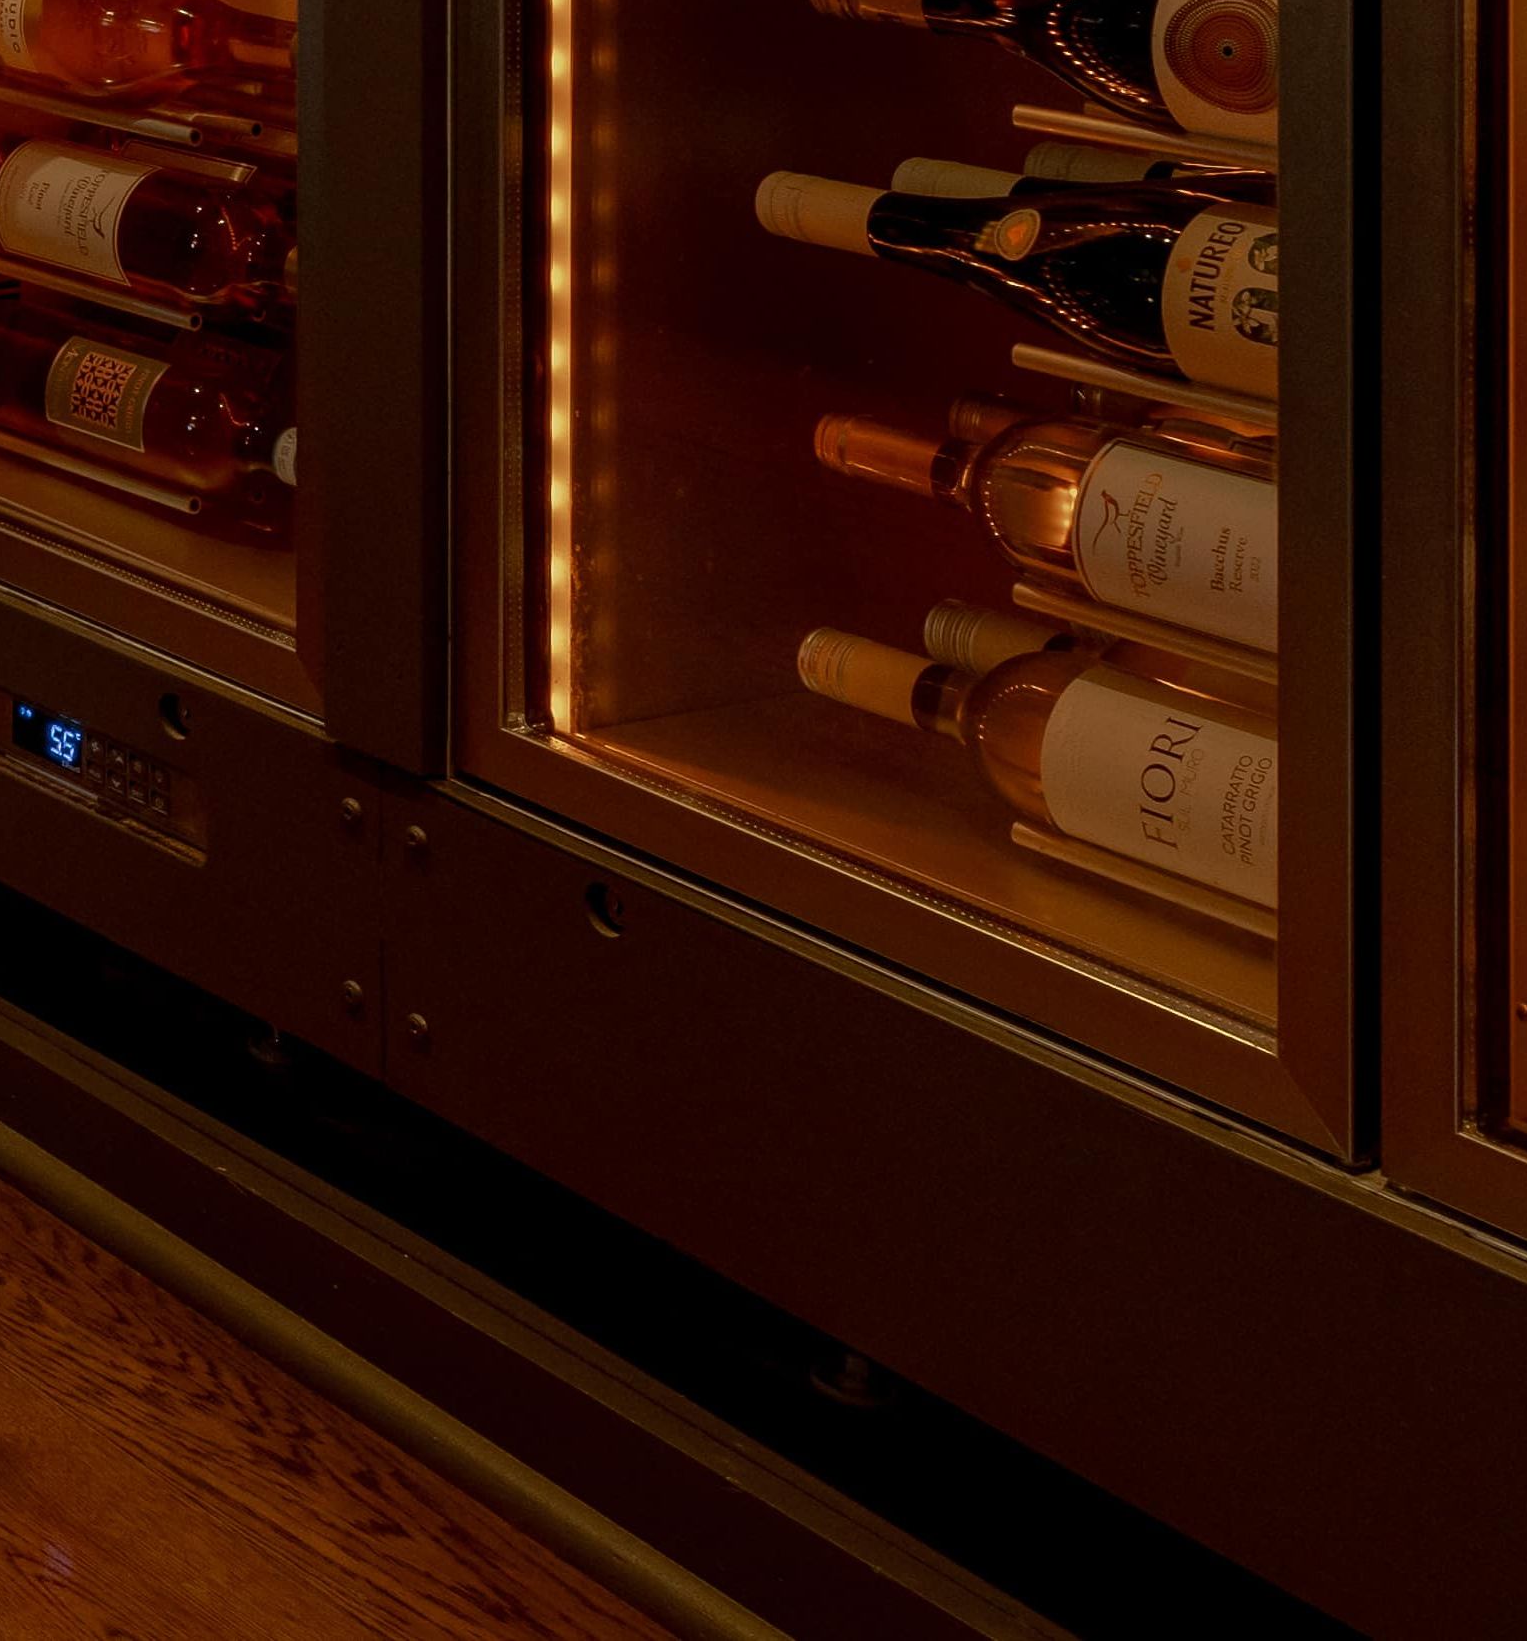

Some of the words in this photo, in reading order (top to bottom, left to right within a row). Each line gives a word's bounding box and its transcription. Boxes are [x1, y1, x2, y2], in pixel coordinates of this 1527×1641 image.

[35, 181, 52, 211] Pinot
[1188, 221, 1245, 332] NATUREO
[1126, 473, 1163, 599] TOPPESFIELD
[1146, 497, 1179, 587] Vineyard
[1209, 527, 1232, 593] Bacchus
[1228, 537, 1248, 594] Reserve
[1138, 717, 1202, 851] FIORI
[1220, 755, 1254, 856] CATARRATTO
[1241, 757, 1273, 813] GRIGIO
[1237, 814, 1255, 866] PINOT
